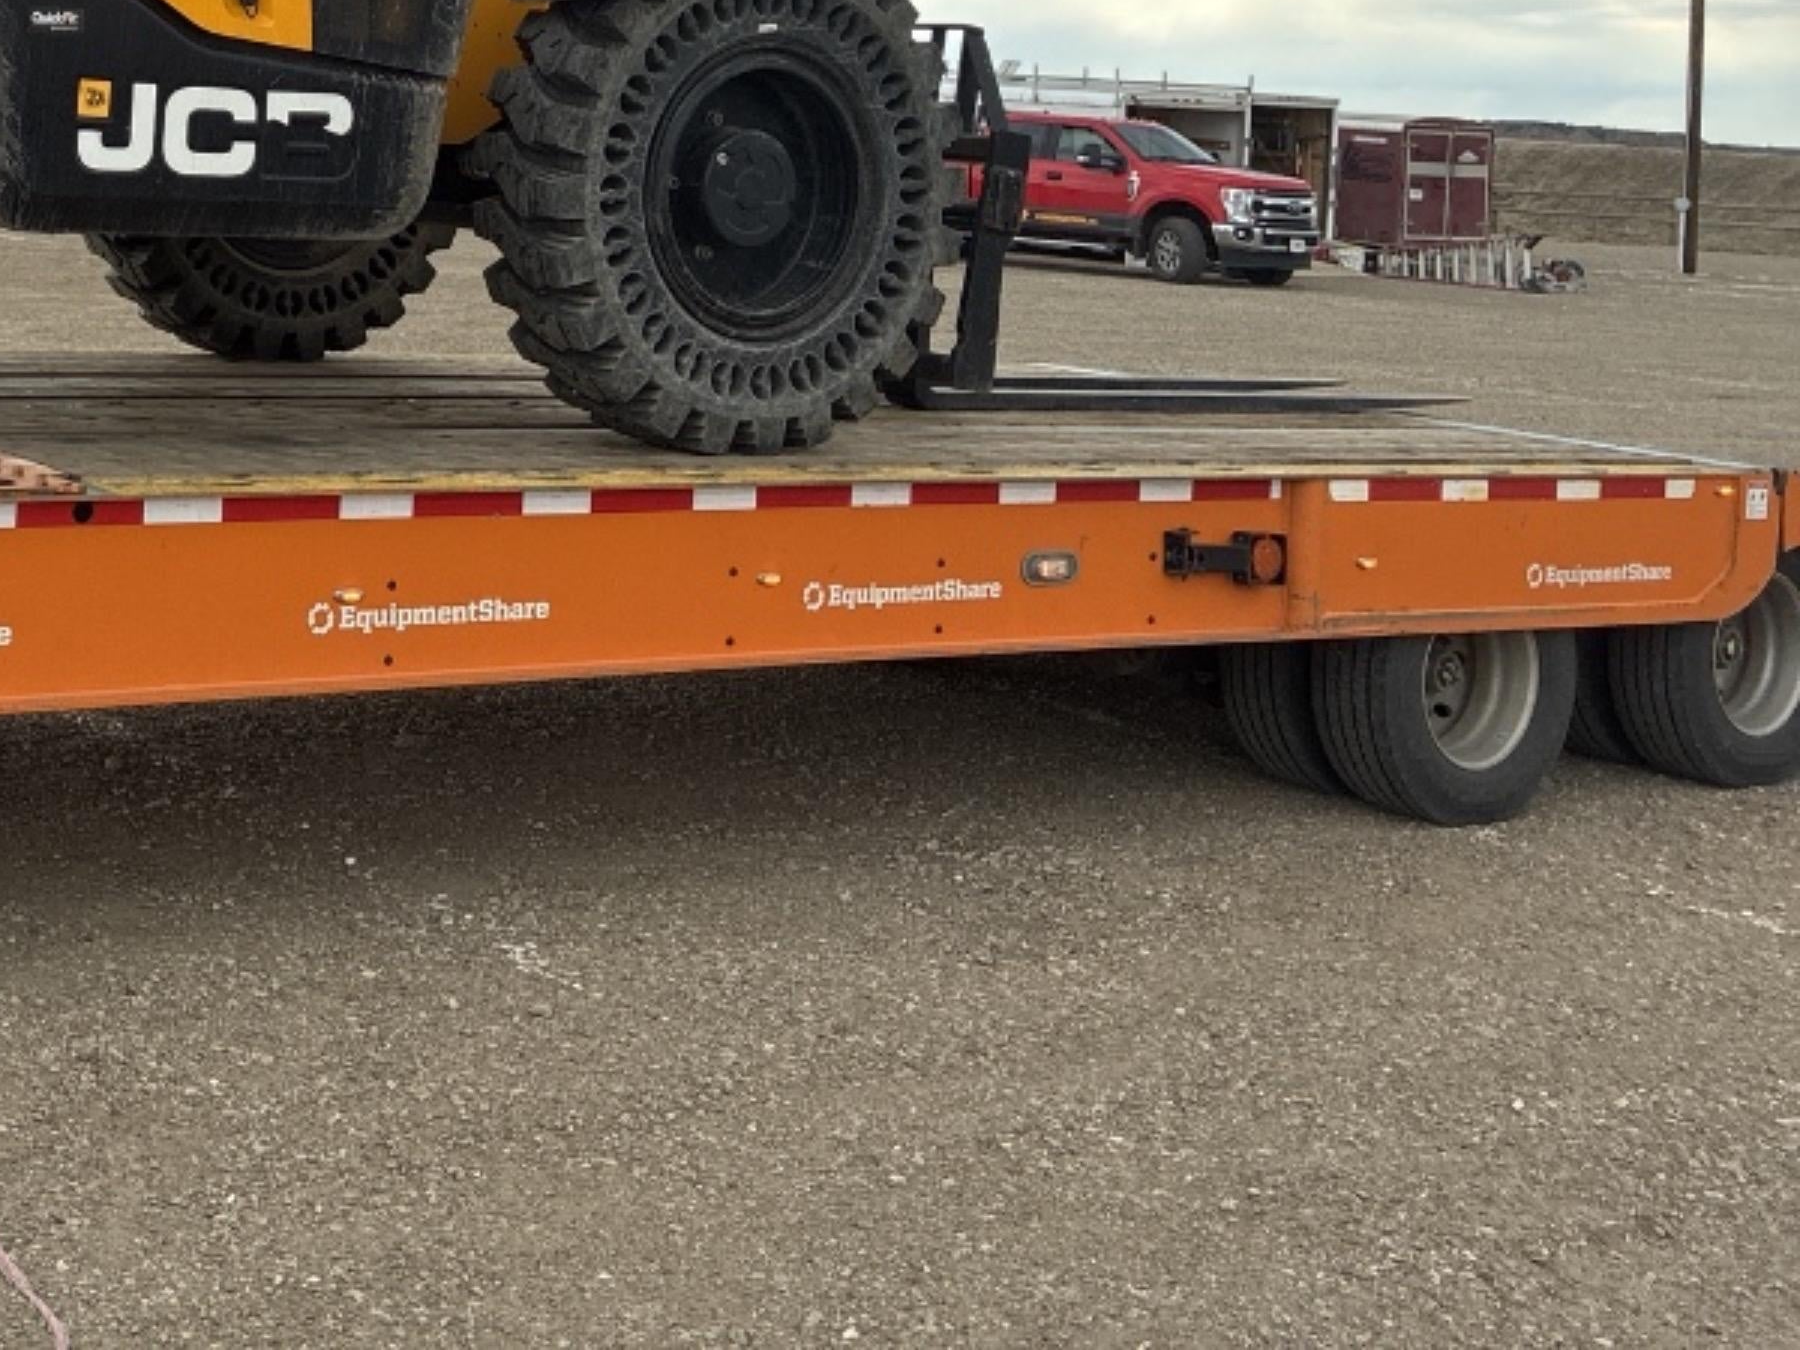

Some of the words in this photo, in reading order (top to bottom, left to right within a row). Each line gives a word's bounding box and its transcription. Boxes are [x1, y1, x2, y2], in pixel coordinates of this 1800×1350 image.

[1544, 563, 1673, 590] EquipmentShare
[826, 578, 1003, 610] EquipmentShare
[338, 596, 550, 634] EquipmentShare
